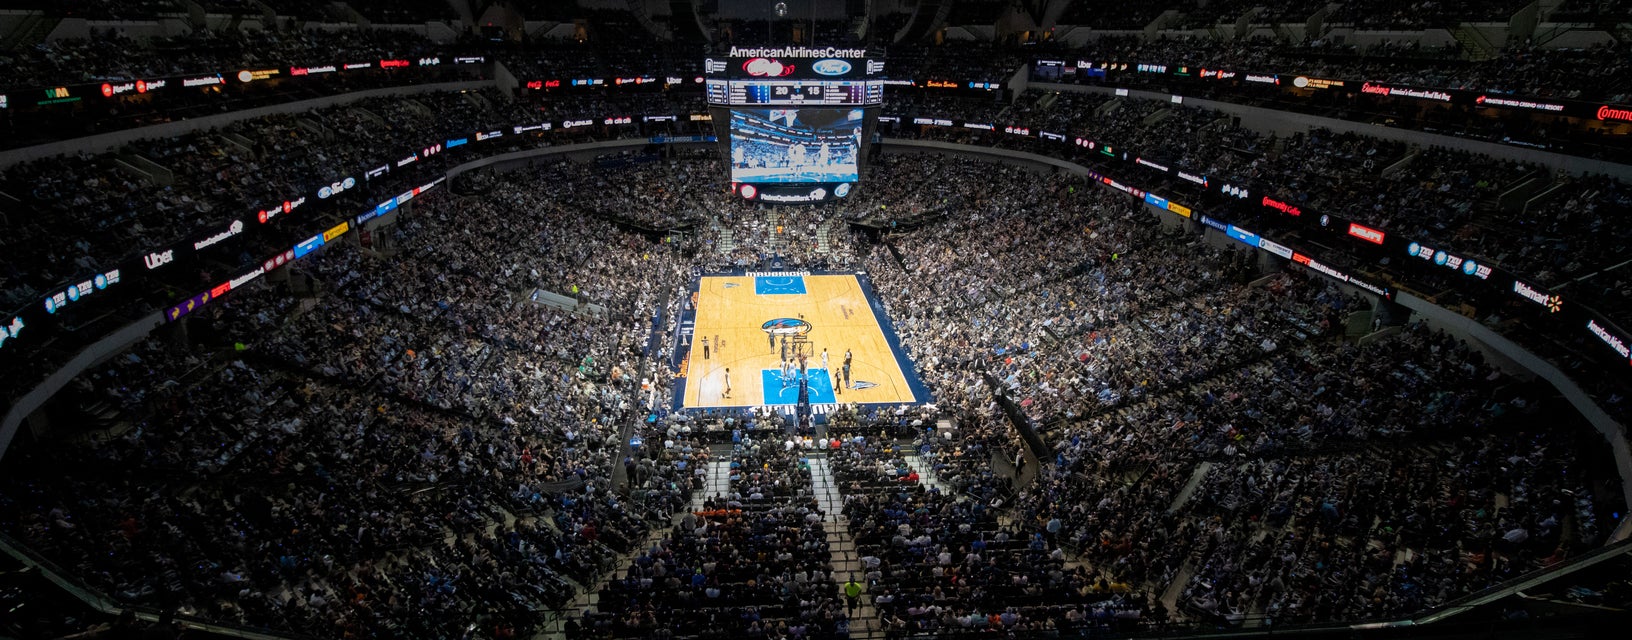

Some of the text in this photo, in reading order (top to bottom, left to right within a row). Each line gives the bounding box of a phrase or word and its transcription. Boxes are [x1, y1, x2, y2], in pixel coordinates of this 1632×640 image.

[729, 46, 866, 58] AmericanAirlinesCenter
[1077, 60, 1092, 69] Uber
[666, 77, 682, 85] Uber
[775, 86, 788, 95] 20
[807, 86, 820, 95] 15
[1419, 245, 1434, 257] TXU
[144, 249, 173, 270] Uber
[1447, 254, 1462, 266] TXU
[105, 269, 120, 281] TXU
[1476, 264, 1492, 276] TXU
[77, 280, 92, 291] TXU
[1348, 276, 1384, 296] AmericanAirlines
[53, 292, 66, 304] TXU
[1514, 280, 1549, 306] Walmart
[1587, 319, 1630, 358] AmericanAirlines
